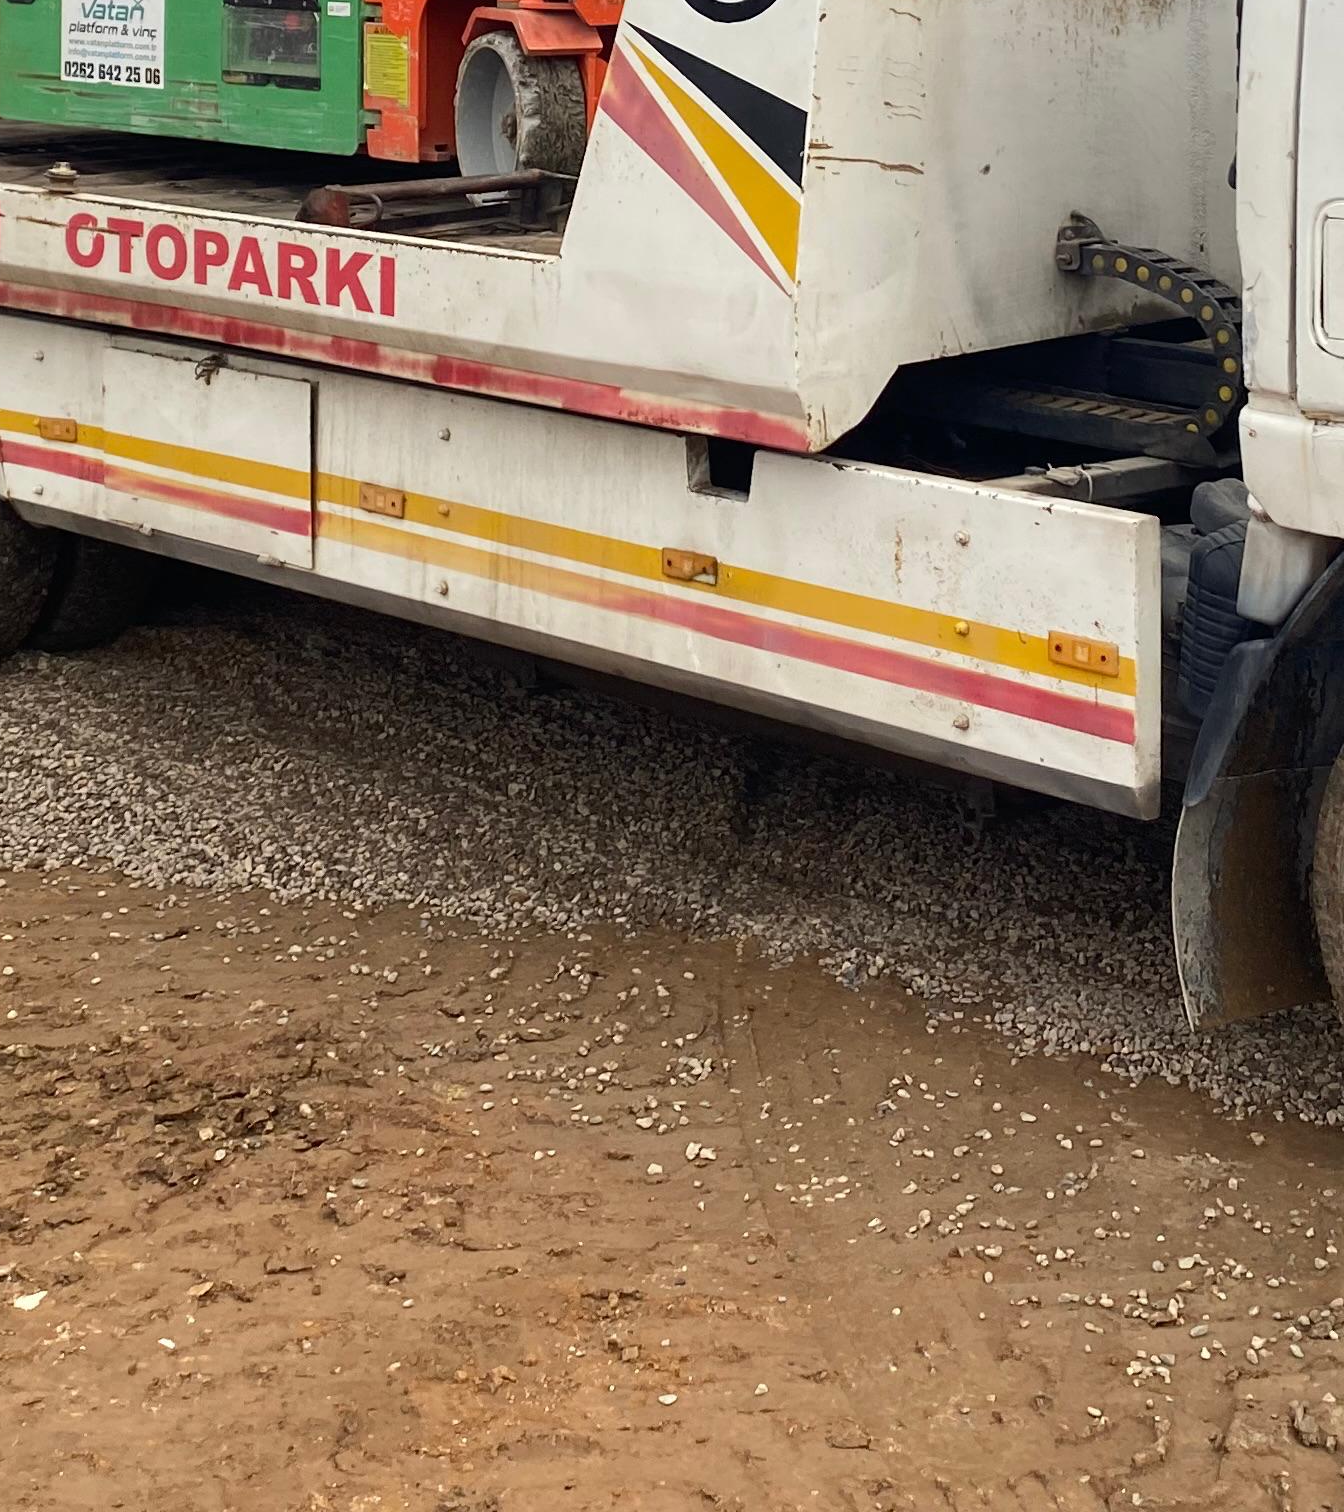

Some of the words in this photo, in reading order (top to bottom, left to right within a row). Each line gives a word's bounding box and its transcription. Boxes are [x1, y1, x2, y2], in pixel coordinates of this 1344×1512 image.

[69, 21, 118, 35] platform
[121, 24, 129, 36] &
[132, 27, 158, 41] vinç
[64, 61, 95, 79] 0262
[98, 63, 122, 81] 642
[125, 65, 141, 83] 25
[145, 67, 161, 85] 06
[65, 212, 396, 317] OTOPARKI
